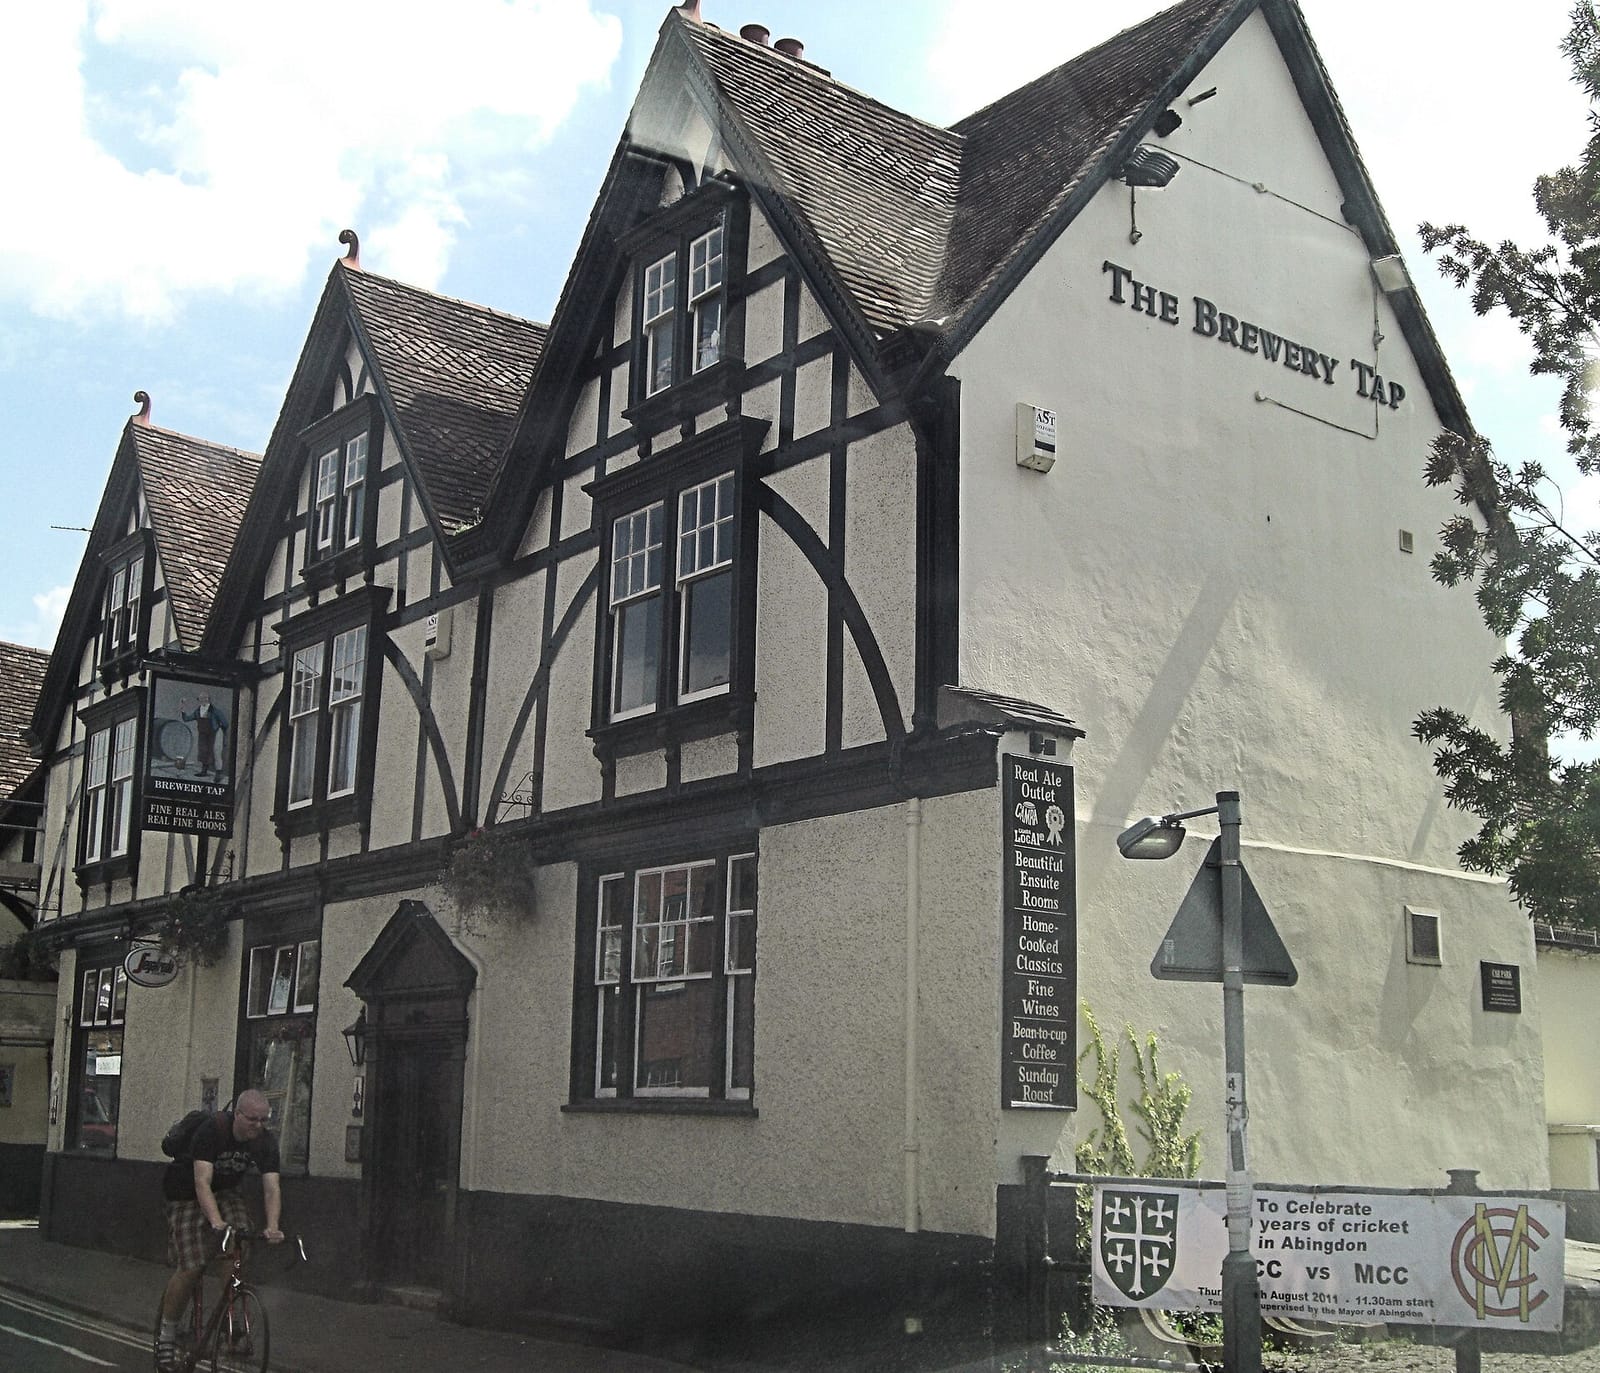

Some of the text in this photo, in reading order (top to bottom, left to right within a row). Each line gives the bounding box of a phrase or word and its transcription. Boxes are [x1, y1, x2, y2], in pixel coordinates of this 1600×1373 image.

[1102, 259, 1406, 410] THE BREWERY TAP
[1014, 764, 1062, 788] Real Ale
[155, 780, 225, 796] BREWERY TAP
[1021, 782, 1056, 803] Outlet
[150, 804, 226, 821] FINE REAL ALES
[147, 814, 227, 832] REAL FINE ROOMS
[1015, 850, 1064, 873] Beautiful
[1019, 870, 1060, 890] Ensuite
[1022, 889, 1059, 910] Rooms
[1019, 935, 1059, 954] Cooked
[1016, 954, 1063, 974] Classics
[1027, 979, 1054, 997] Fine
[1022, 999, 1059, 1017] Wines
[1013, 1021, 1067, 1045] Bean-to-cup
[1022, 1043, 1057, 1060] Coffee
[1018, 1065, 1059, 1088] Sunday
[1022, 1084, 1054, 1102] Roast
[1256, 1198, 1279, 1213] To
[1286, 1200, 1372, 1216] Celebrate
[1259, 1218, 1311, 1233] years
[1317, 1218, 1335, 1232] of
[1342, 1219, 1409, 1234] cricket
[1258, 1236, 1367, 1255] in Abingdon
[1306, 1266, 1330, 1280] vs
[1354, 1262, 1409, 1285] MCC
[1270, 1290, 1308, 1303] August
[1312, 1292, 1338, 1305] 2011
[1355, 1296, 1403, 1307] 11.30am
[1405, 1297, 1434, 1308] start
[1260, 1303, 1304, 1313] upervised
[1307, 1305, 1319, 1314] by
[1322, 1306, 1336, 1315] the
[1338, 1307, 1364, 1317] Mayor
[1366, 1308, 1376, 1316] of
[1379, 1309, 1424, 1318] Abingdon
